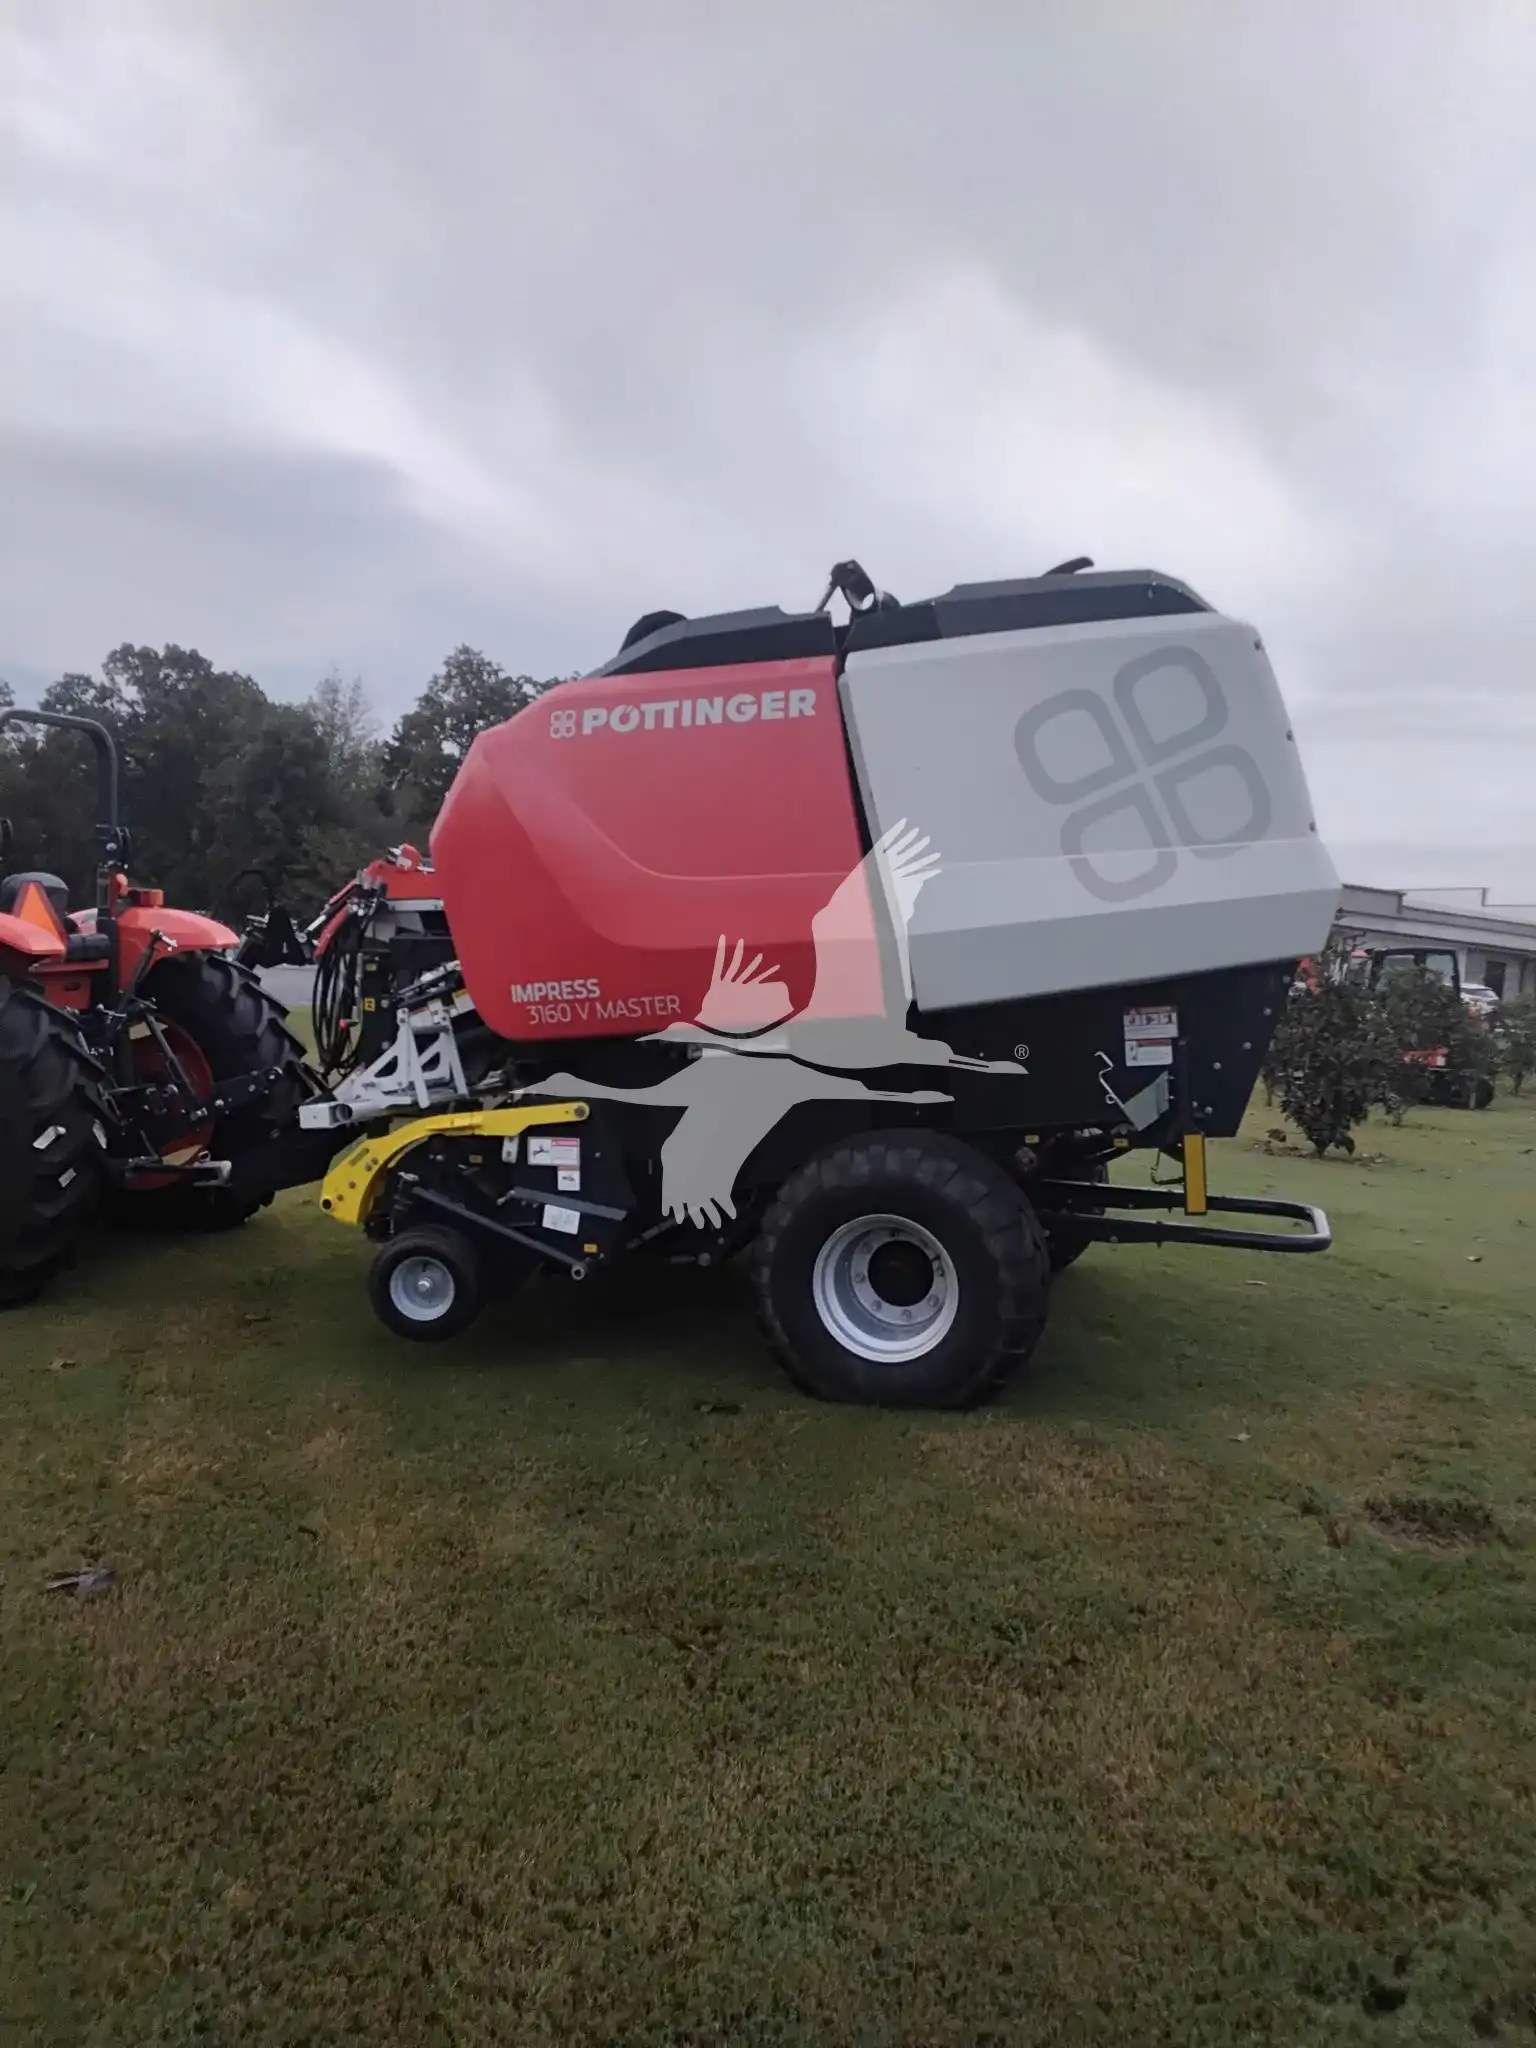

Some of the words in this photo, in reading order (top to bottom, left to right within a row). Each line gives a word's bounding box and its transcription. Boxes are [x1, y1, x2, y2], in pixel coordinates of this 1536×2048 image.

[582, 689, 817, 735] PÖTTINGER
[511, 978, 600, 1003] IMPRESS
[526, 1003, 571, 1025] 3160
[575, 1003, 590, 1021] V
[596, 995, 682, 1019] MASTER
